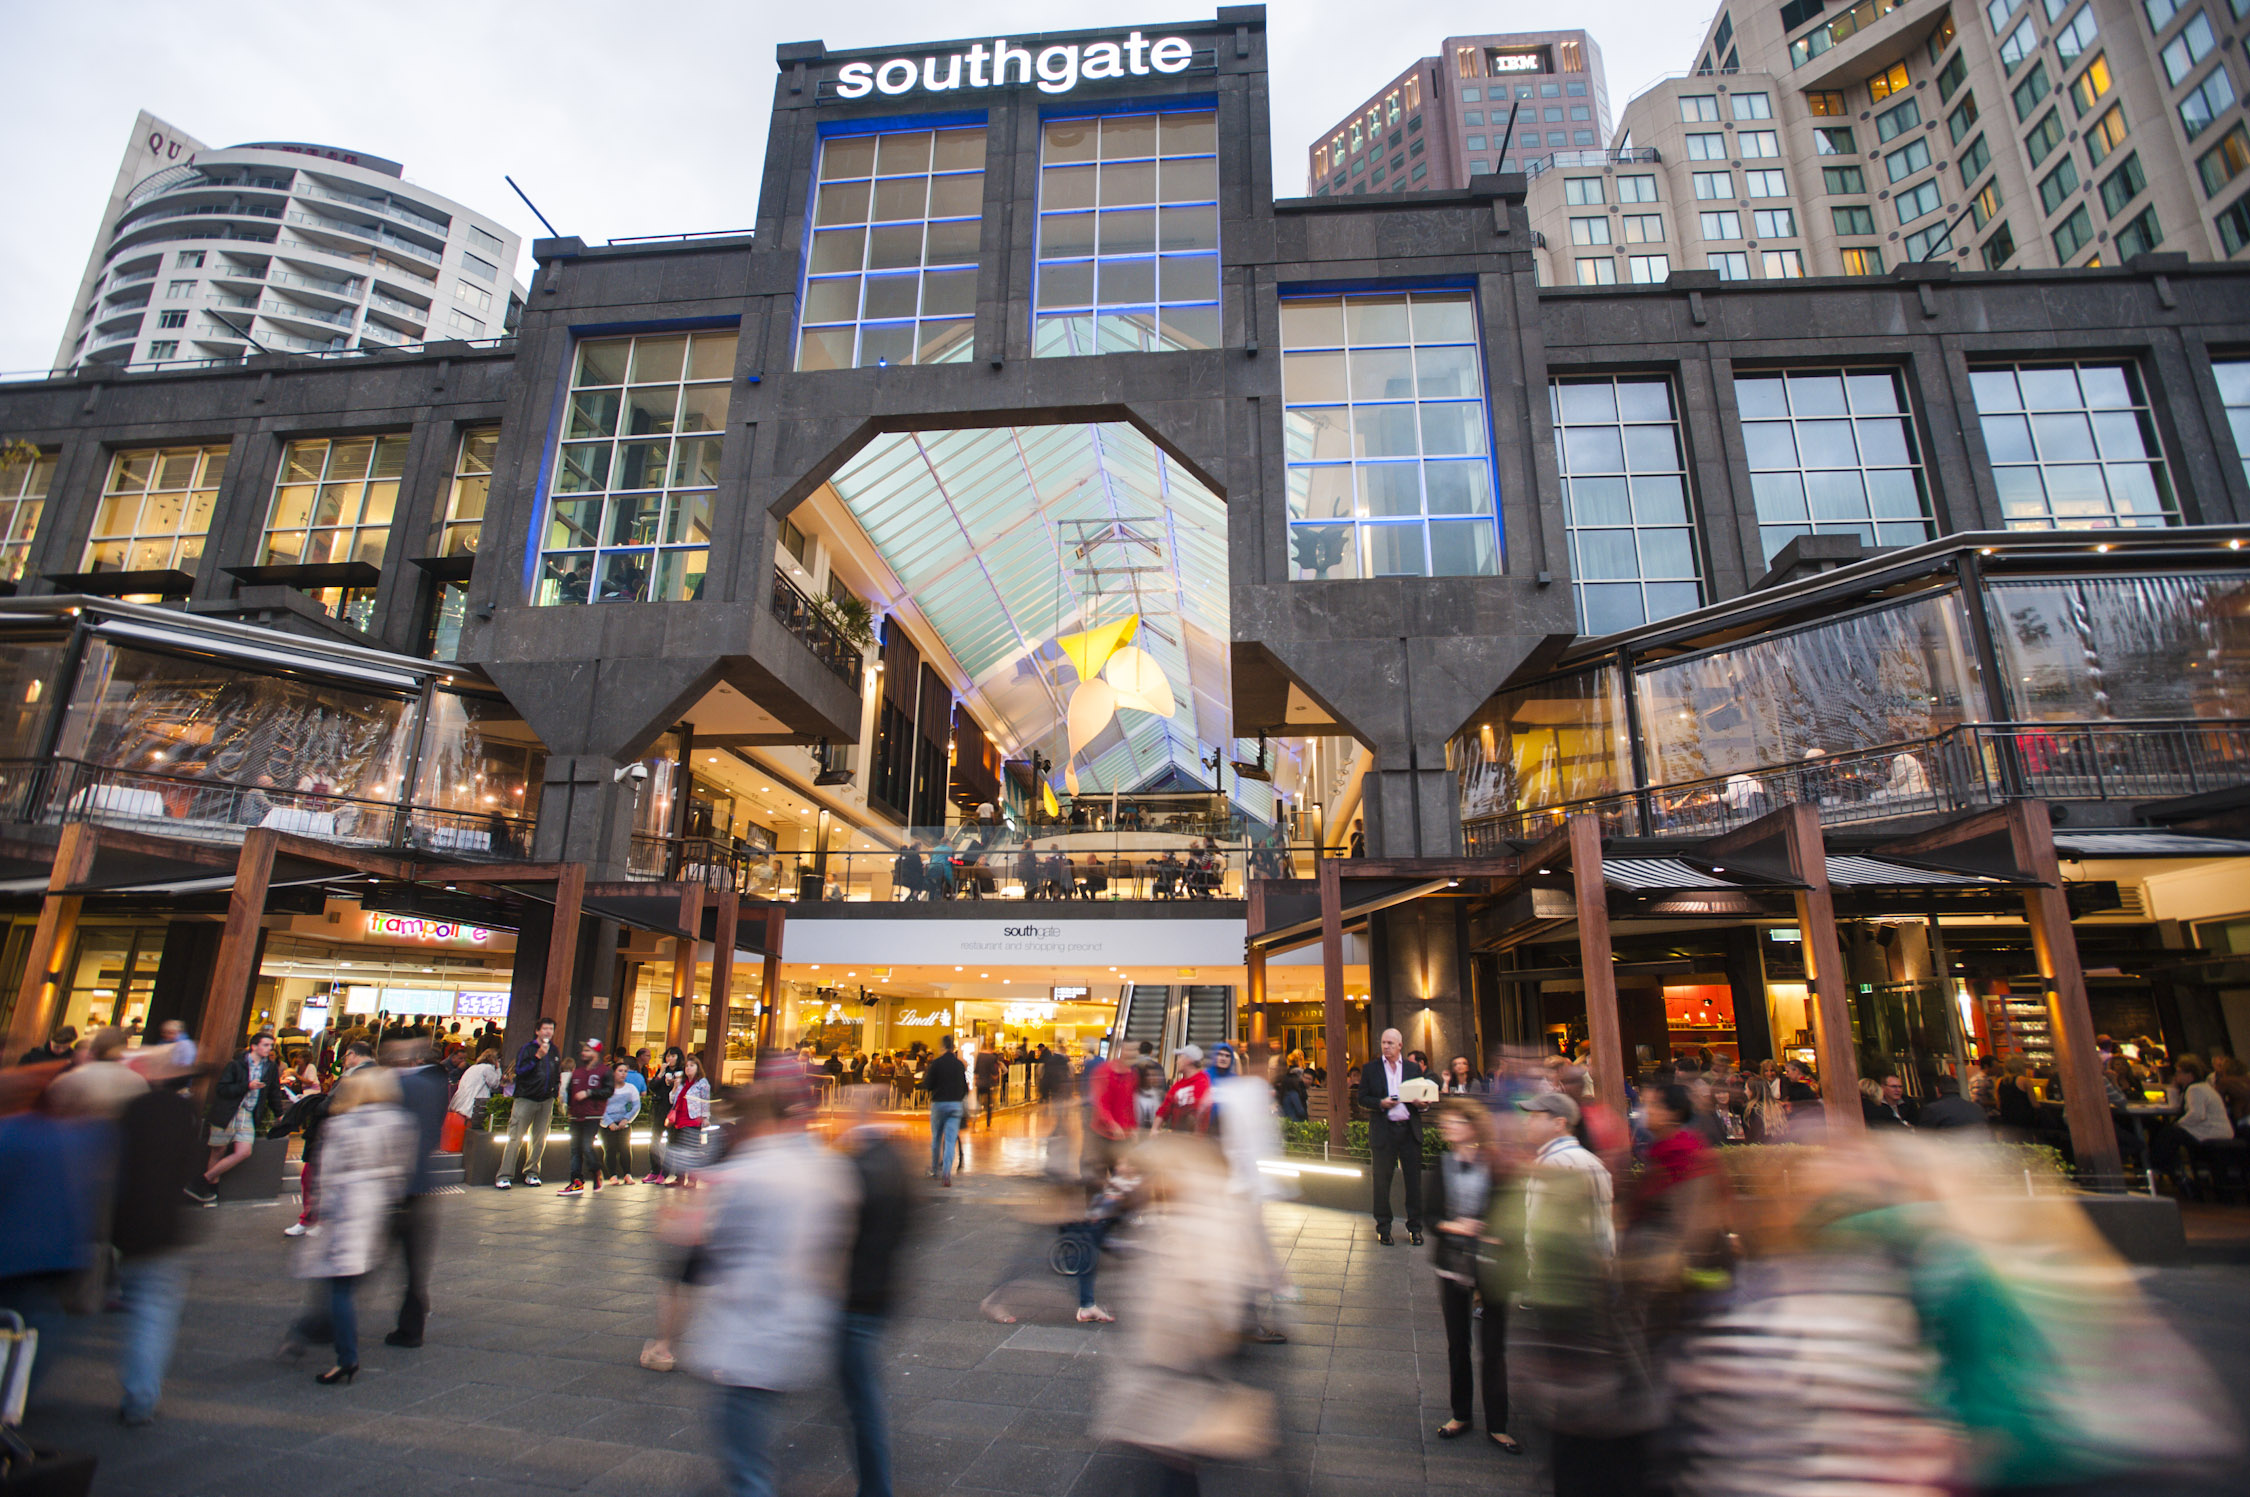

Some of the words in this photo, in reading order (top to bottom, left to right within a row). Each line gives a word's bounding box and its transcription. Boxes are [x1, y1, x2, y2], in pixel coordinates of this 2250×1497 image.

[836, 31, 1193, 99] southgate
[1496, 55, 1538, 71] IBM
[1004, 925, 1060, 939] southgate
[960, 942, 1001, 951] restaurant
[1005, 941, 1022, 950] and
[1024, 941, 1065, 952] shopping
[1067, 942, 1103, 952] precinct
[894, 1009, 940, 1026] Lindt
